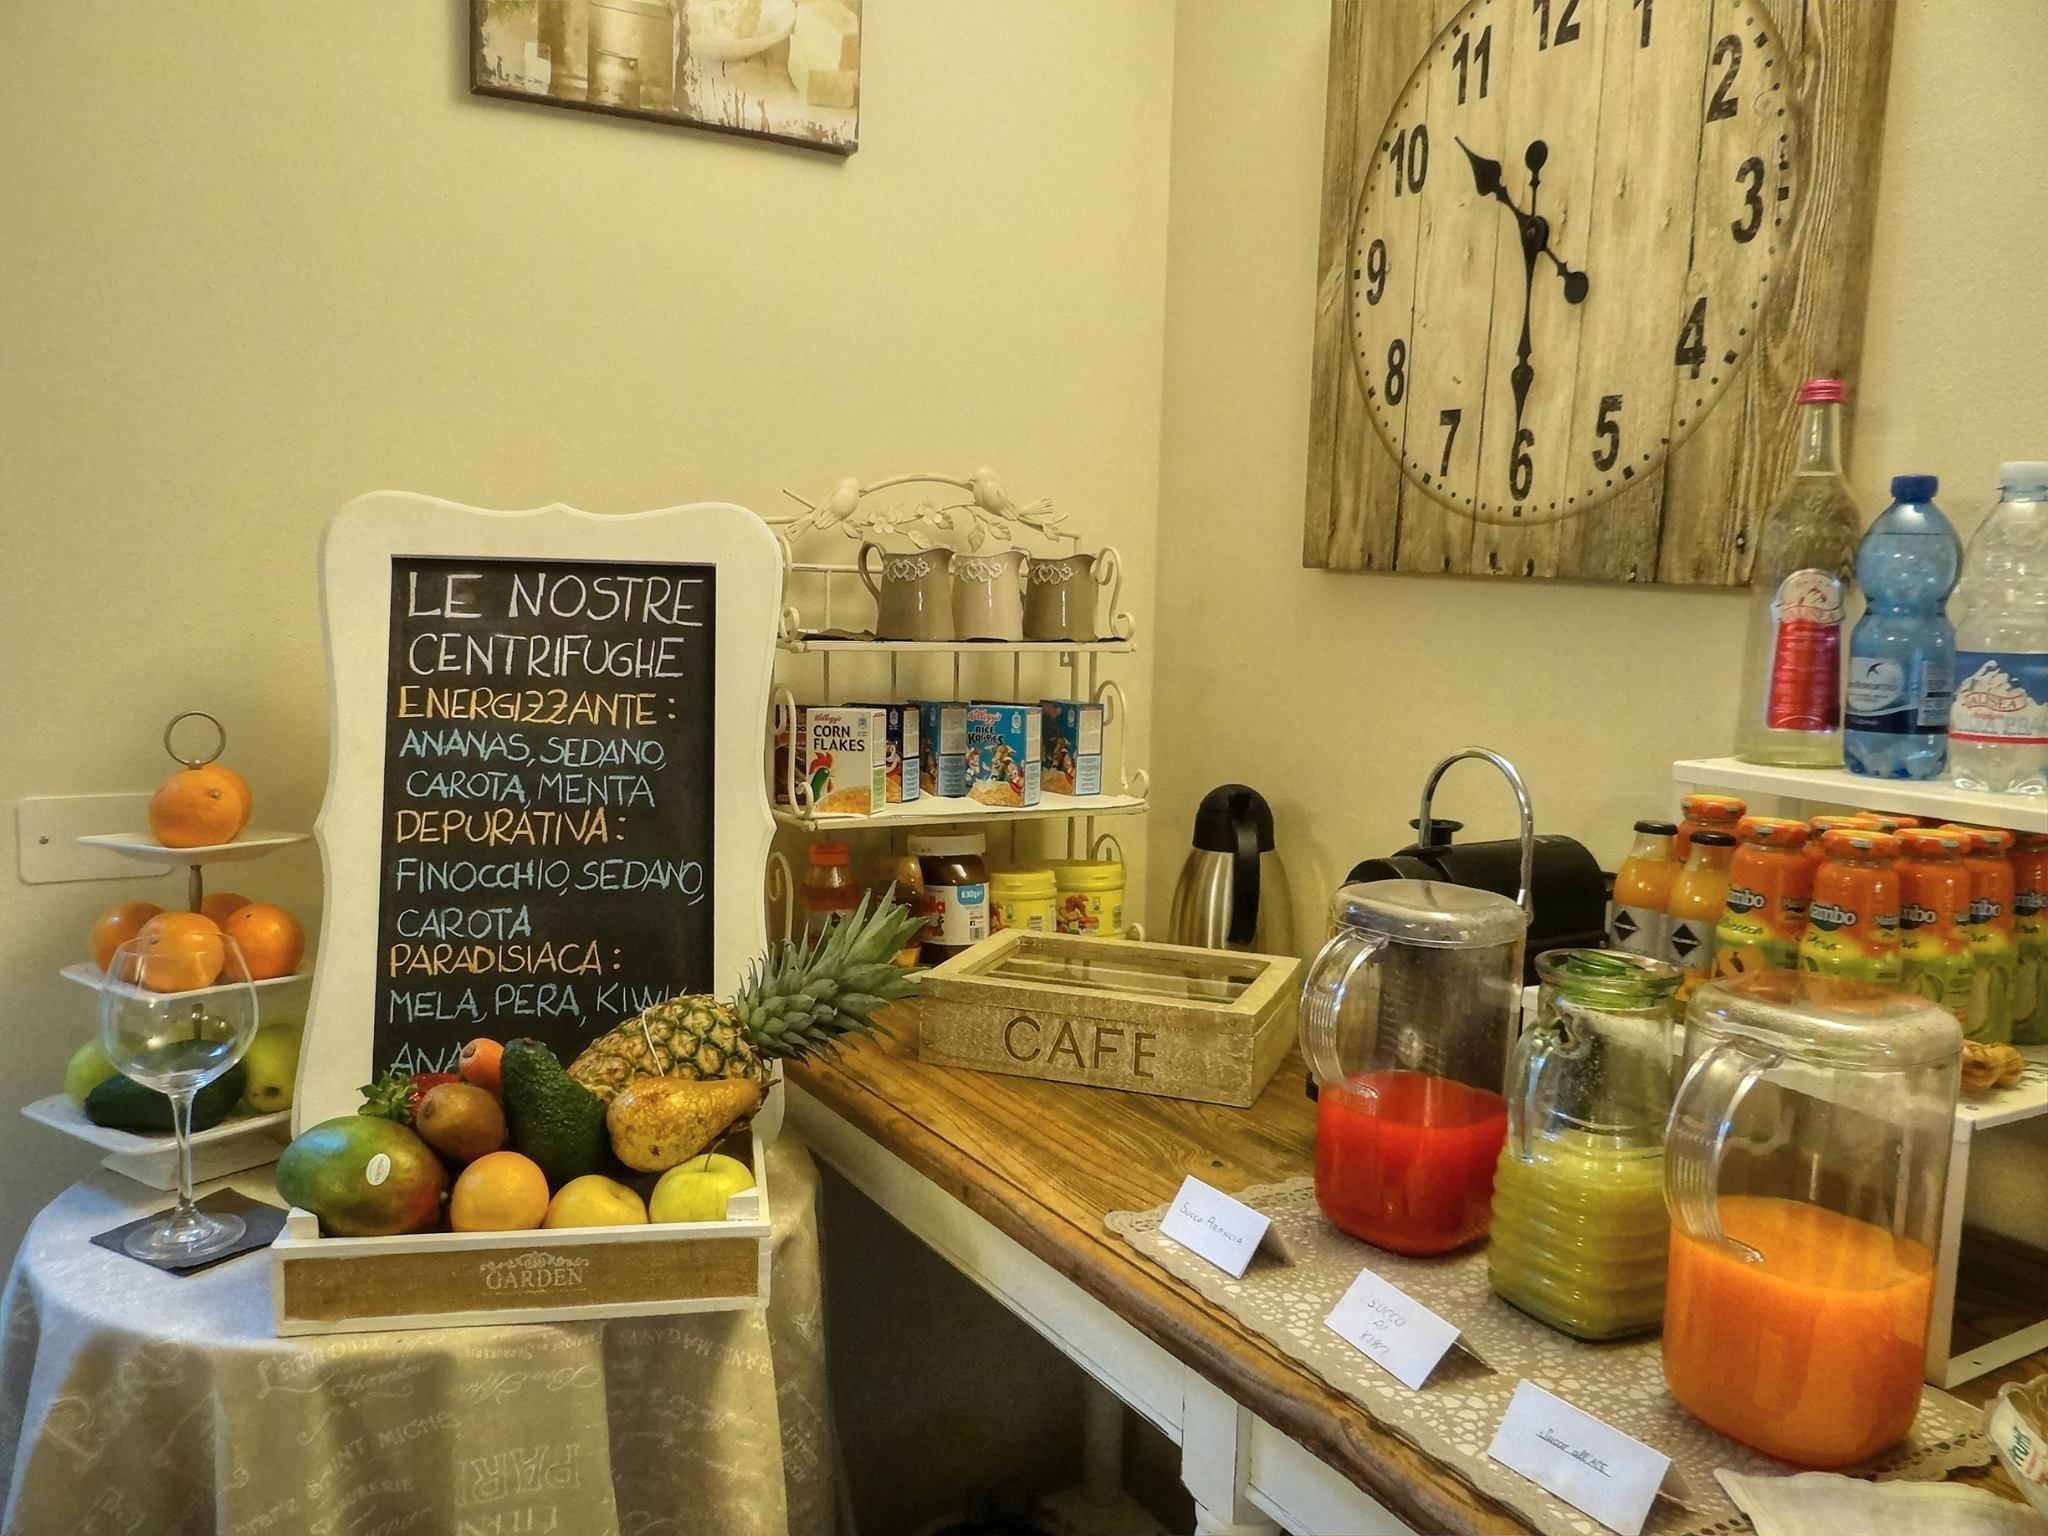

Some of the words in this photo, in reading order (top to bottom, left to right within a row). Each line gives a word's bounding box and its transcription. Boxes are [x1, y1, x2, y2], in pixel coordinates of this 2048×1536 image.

[1533, 0, 1580, 51] 12
[1634, 0, 1653, 48] 1
[1452, 26, 1492, 105] 11
[1707, 34, 1743, 122] 2
[1390, 124, 1429, 197] 10
[1731, 157, 1765, 243] 3
[1366, 239, 1388, 305] 9
[1675, 297, 1707, 379] 4
[1385, 339, 1406, 405] 8
[1440, 409, 1461, 477] 7
[1592, 394, 1623, 472] 5
[1510, 428, 1535, 500] 6
[407, 571, 484, 619] LE
[508, 572, 704, 627] NOSTRE
[408, 632, 686, 680] CENTRIFUGHE
[813, 725, 850, 738] CORN
[813, 738, 865, 752] FLAKES
[975, 726, 994, 734] RICE
[537, 772, 656, 808] MENTA
[396, 905, 533, 940] CAROTA
[389, 988, 488, 1024] MELA,
[494, 983, 588, 1027] PERA,
[389, 1042, 464, 1077] ANA
[1004, 1015, 1158, 1078] CAFE
[485, 1267, 583, 1290] GARDEN
